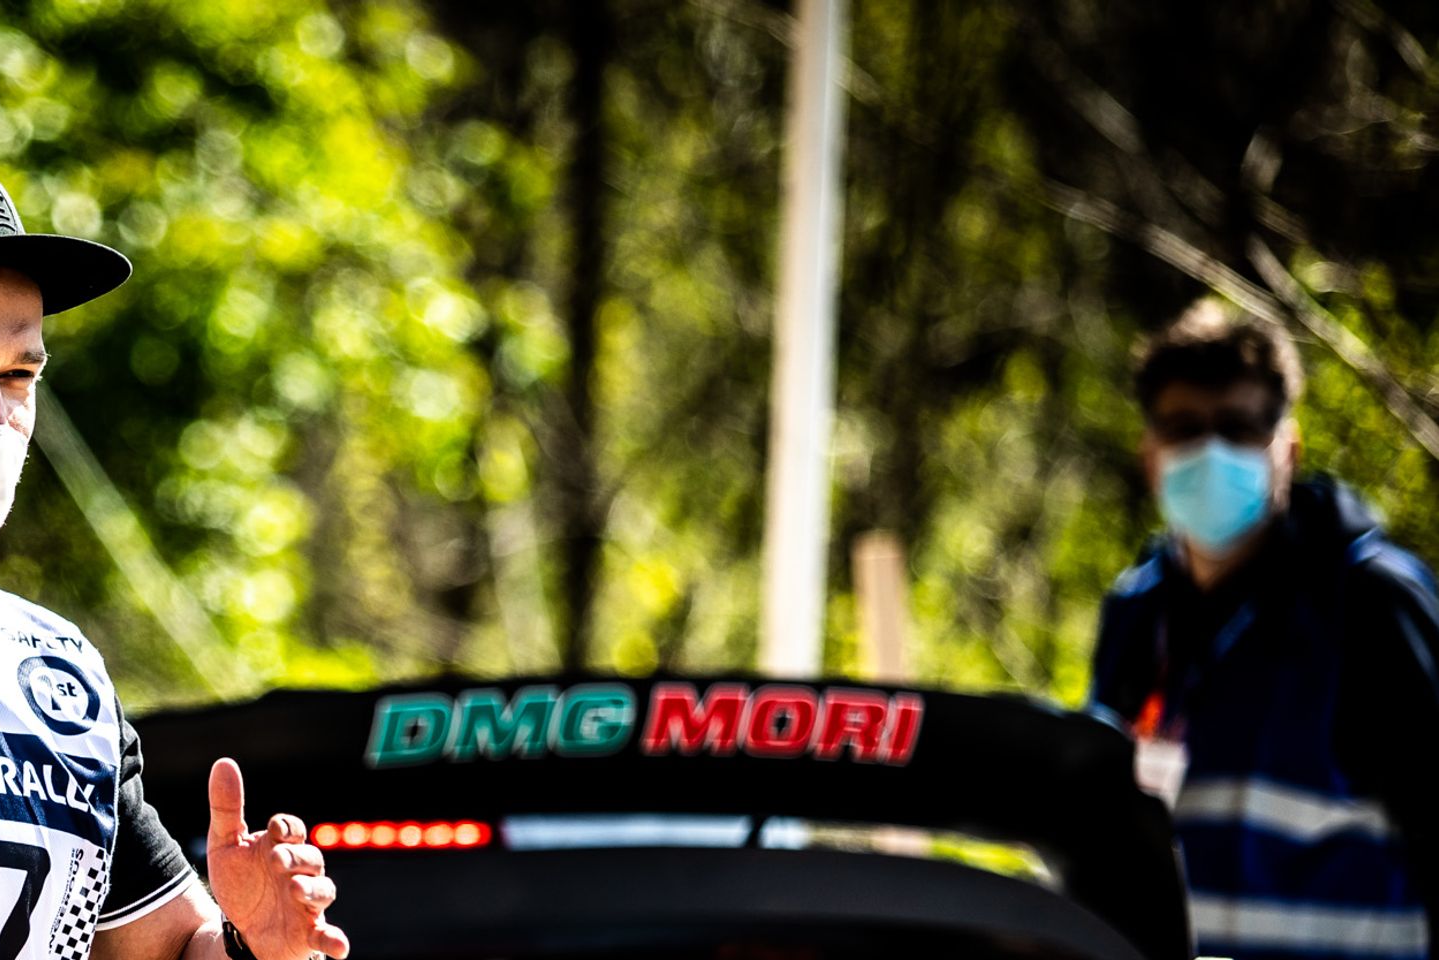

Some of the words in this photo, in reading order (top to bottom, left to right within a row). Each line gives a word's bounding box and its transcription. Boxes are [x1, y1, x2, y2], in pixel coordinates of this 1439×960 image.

[2, 628, 82, 653] AFTY
[366, 686, 636, 769] DMG
[642, 683, 924, 766] MORI
